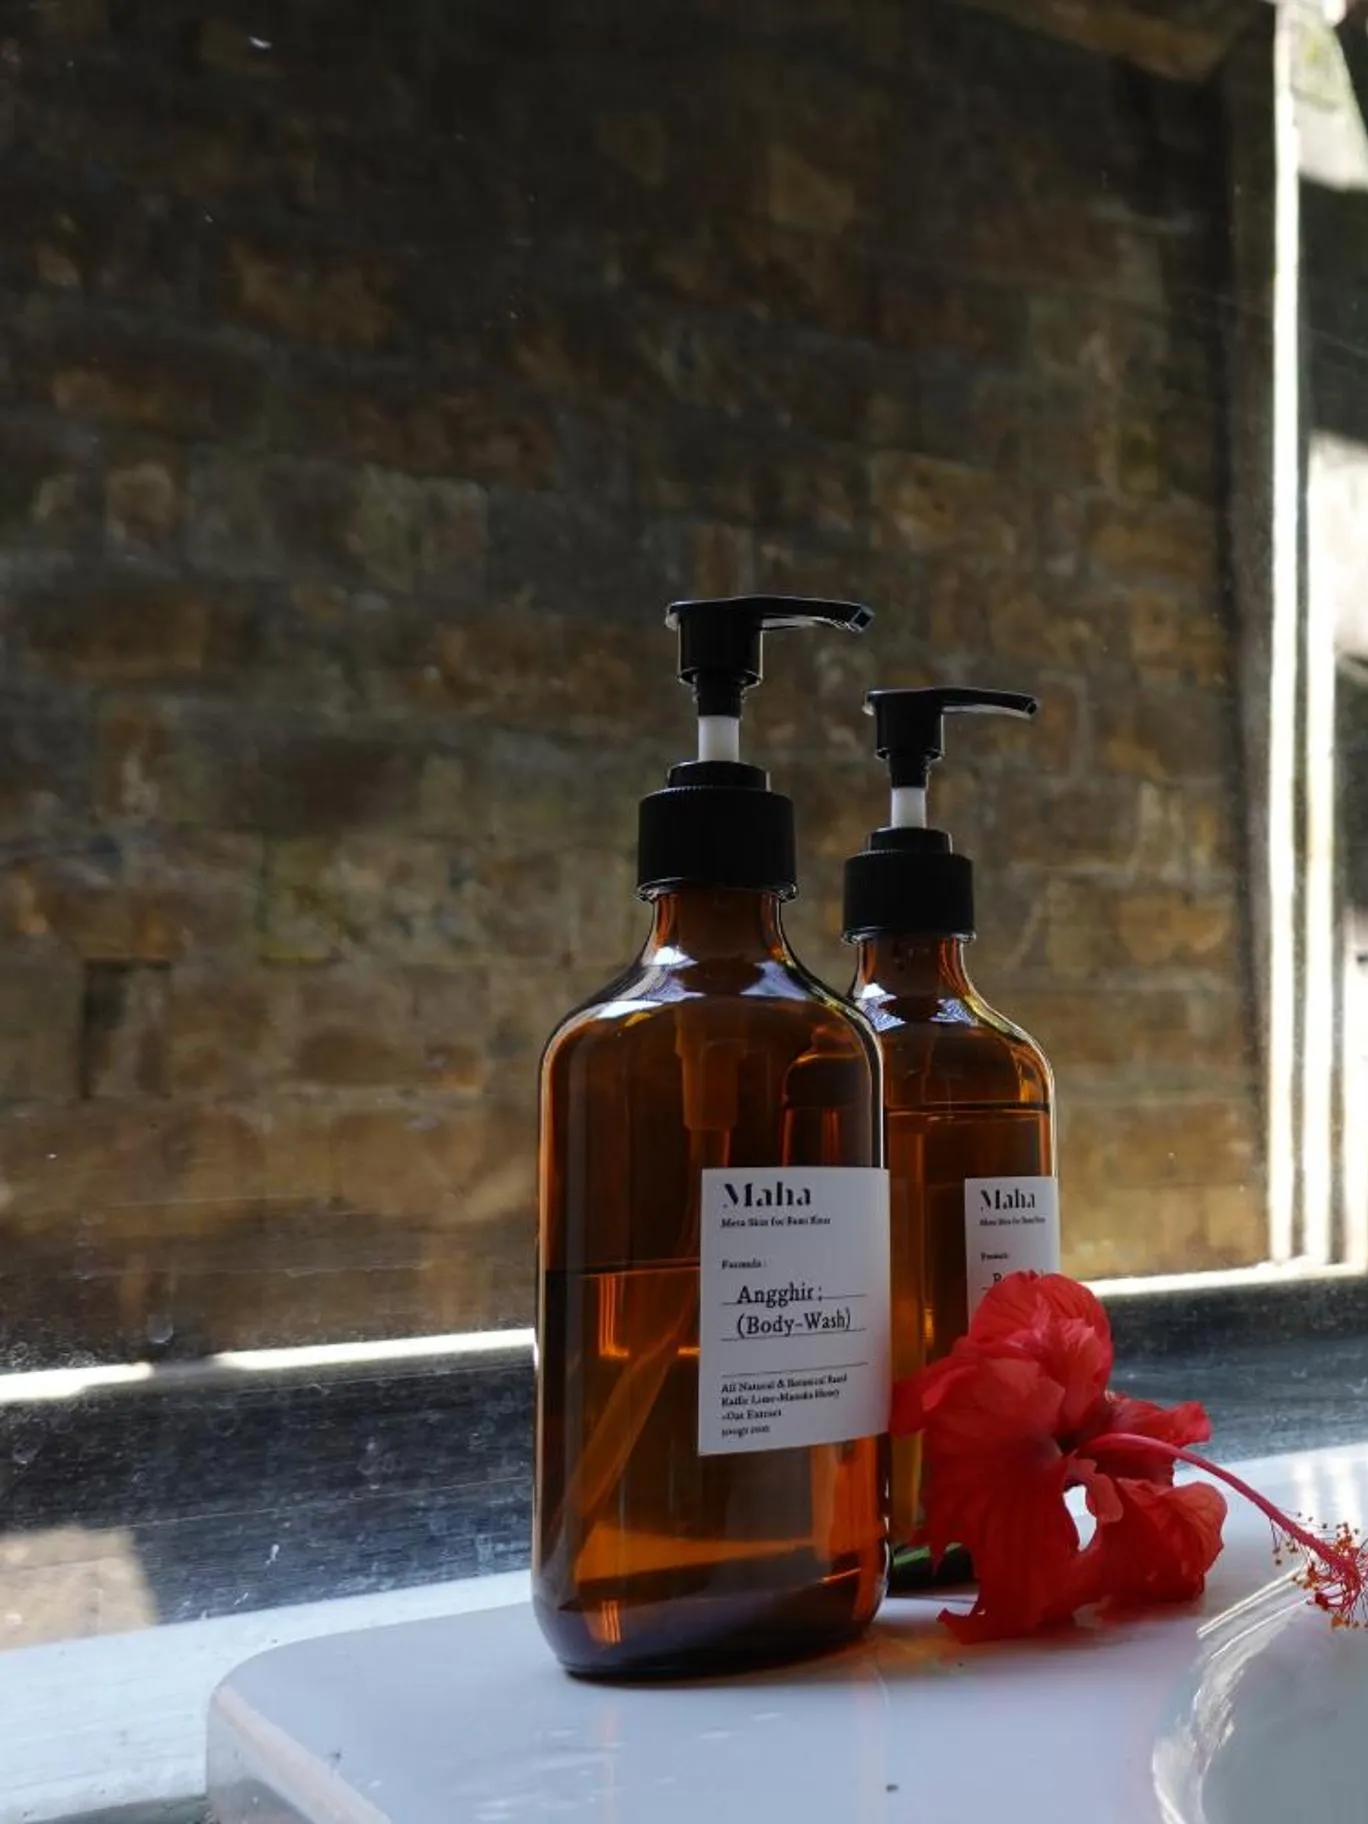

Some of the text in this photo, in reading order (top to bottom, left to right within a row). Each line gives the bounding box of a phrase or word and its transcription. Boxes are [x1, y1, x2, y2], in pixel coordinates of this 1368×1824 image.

[722, 1181, 812, 1208] Maha
[980, 1187, 1036, 1211] Maha
[736, 1308, 851, 1339] (Body-Wash)
